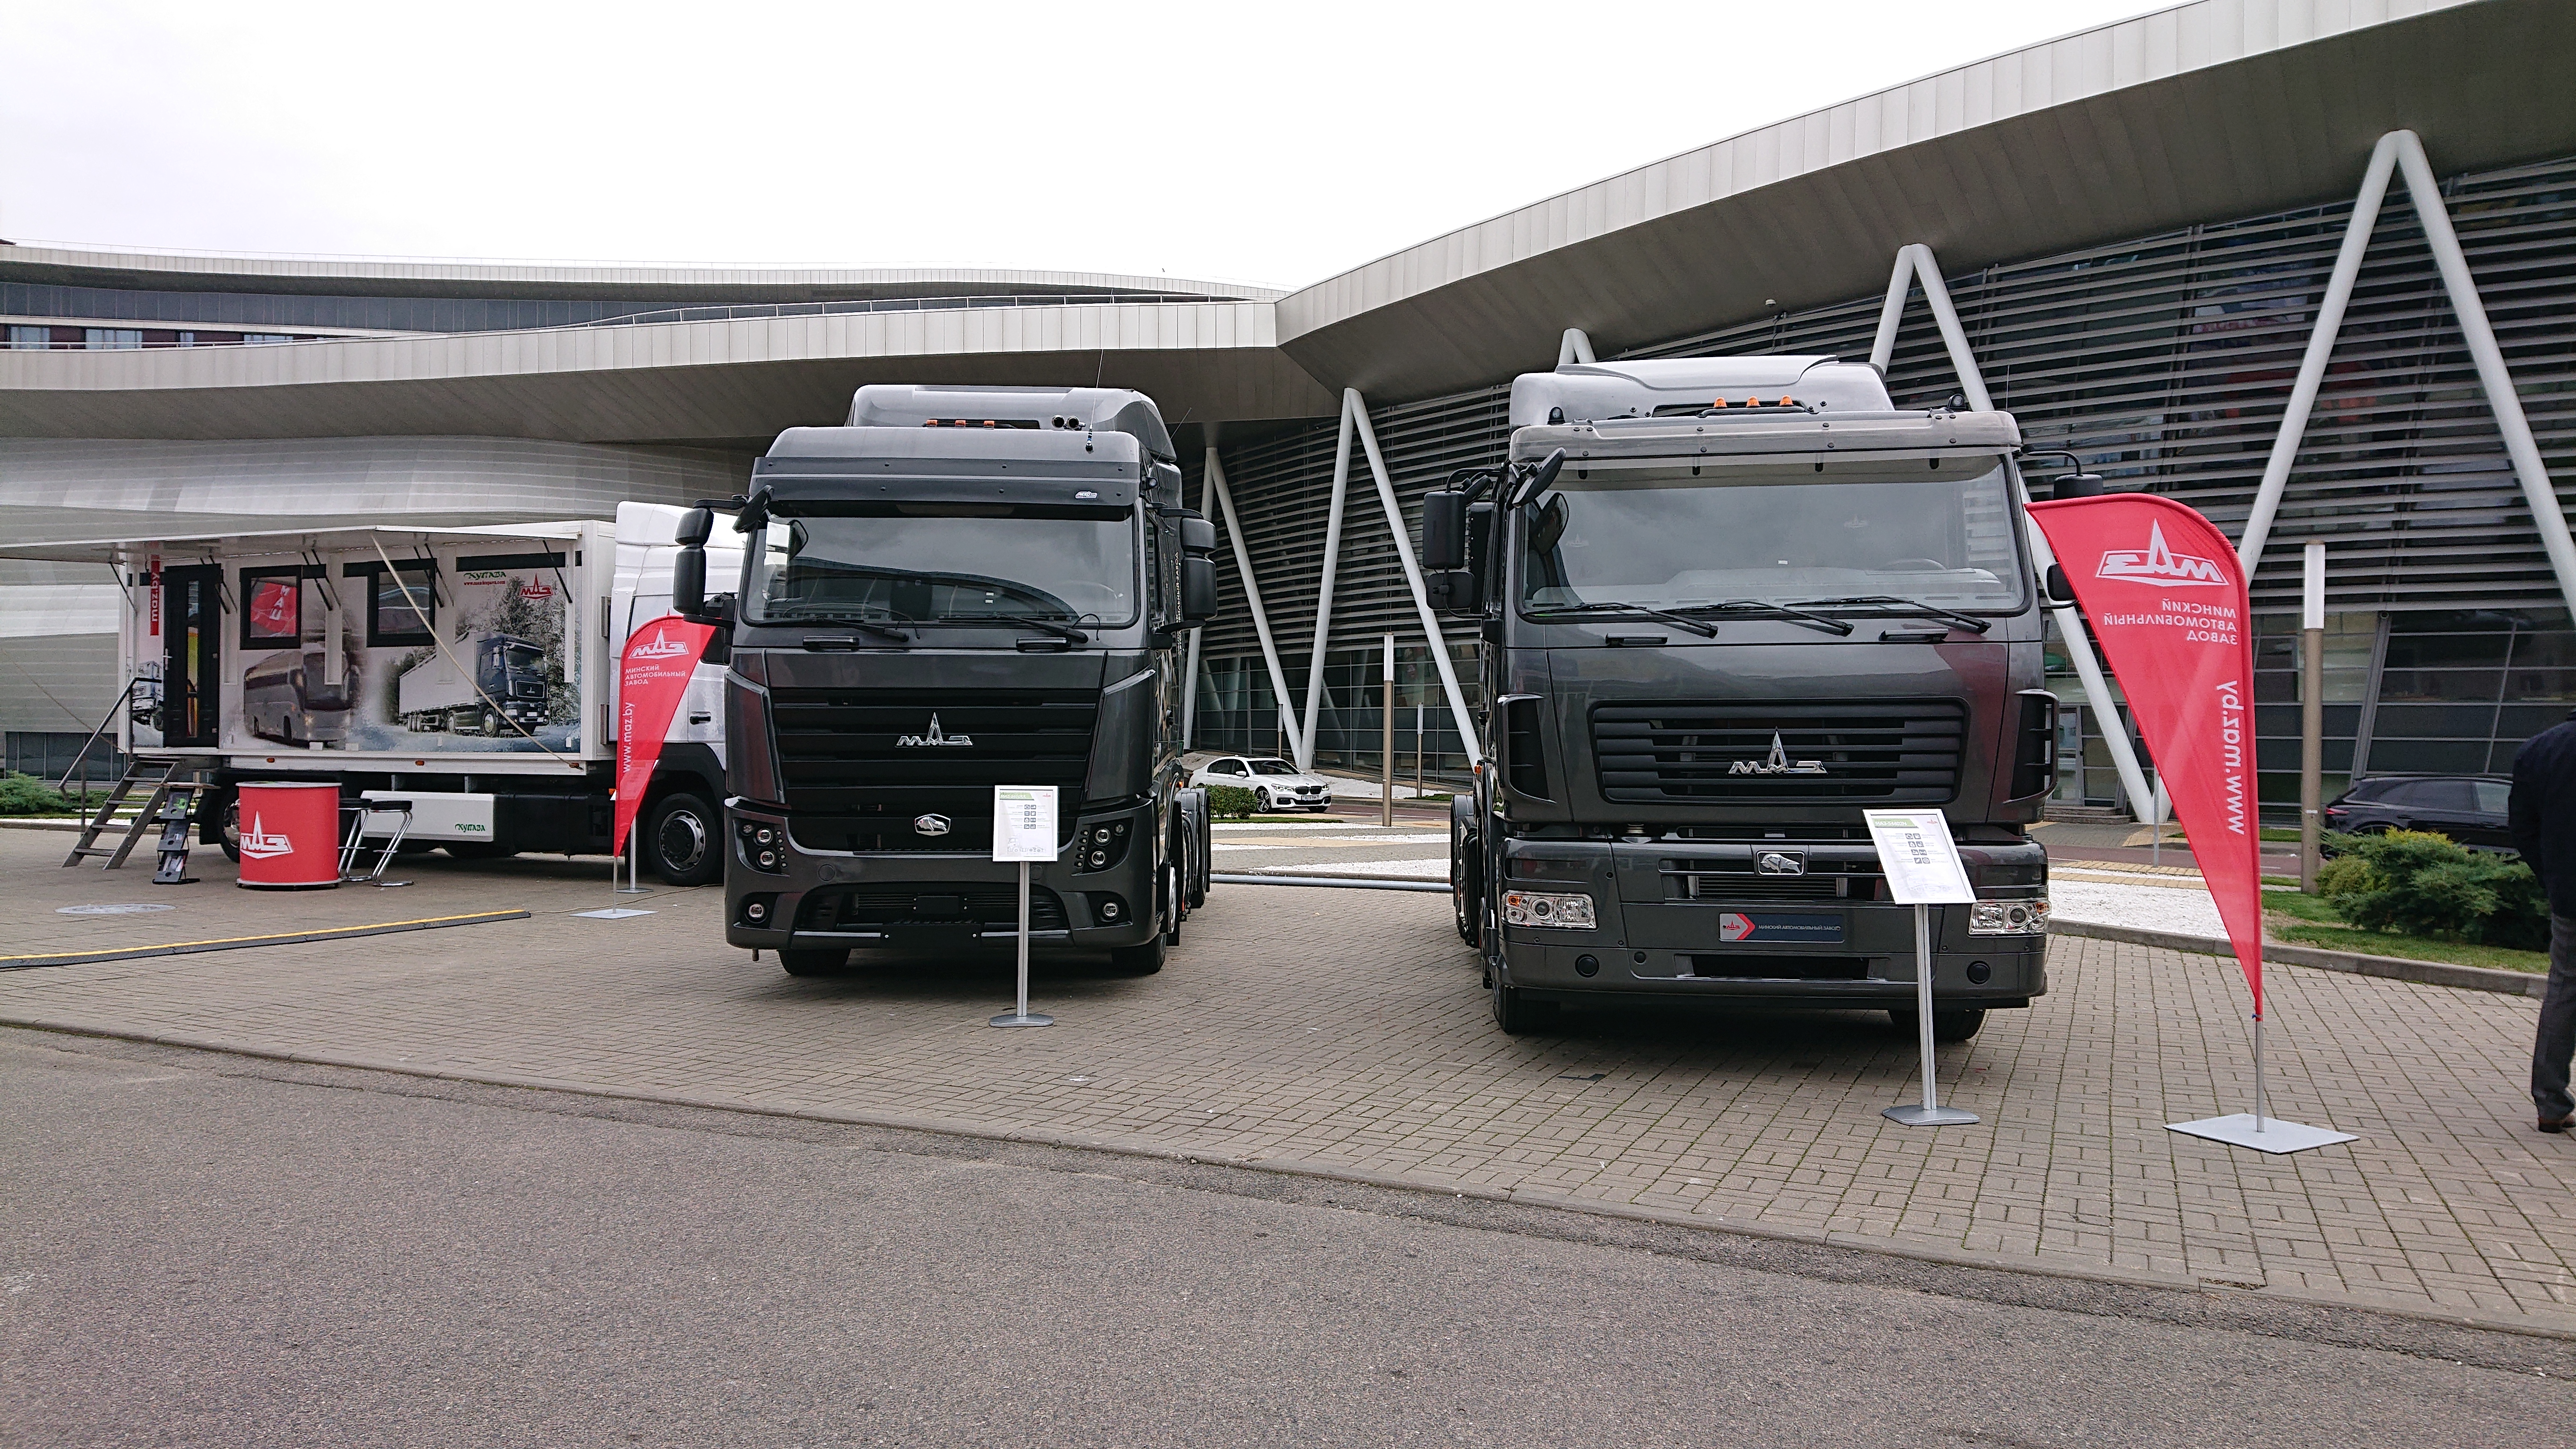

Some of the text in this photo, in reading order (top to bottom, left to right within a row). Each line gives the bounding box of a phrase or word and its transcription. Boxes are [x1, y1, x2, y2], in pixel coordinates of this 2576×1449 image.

[151, 572, 160, 622] maz.by
[631, 626, 686, 657] МАЗ
[625, 664, 659, 674] МИНСКИЙ
[625, 670, 686, 681] АВТОМОБИЛЬНЫЙ
[622, 702, 635, 773] www.maz.by
[895, 711, 973, 746] МАЗ
[1727, 726, 1828, 775] МАЗ
[240, 810, 290, 851] МАЗ
